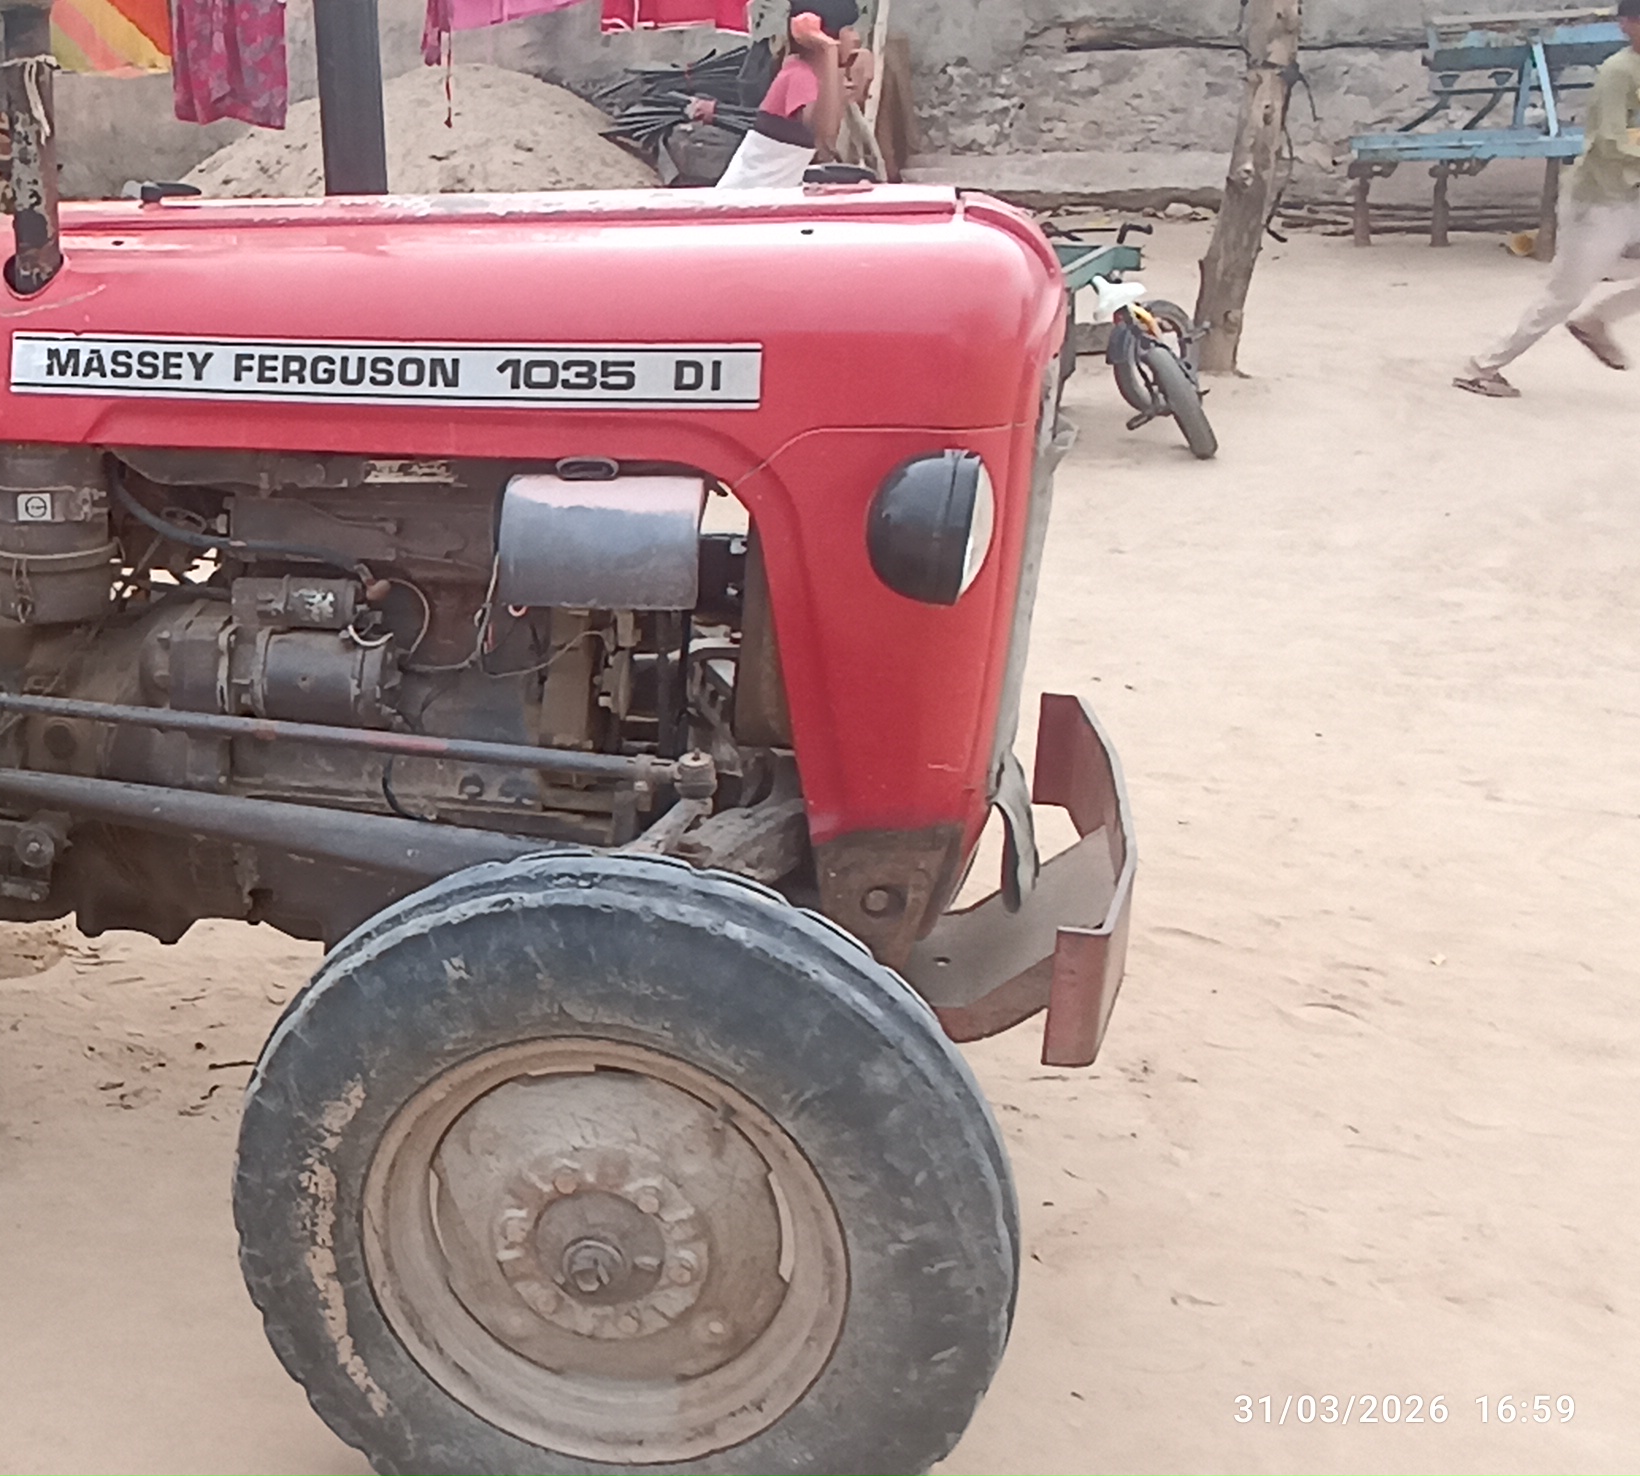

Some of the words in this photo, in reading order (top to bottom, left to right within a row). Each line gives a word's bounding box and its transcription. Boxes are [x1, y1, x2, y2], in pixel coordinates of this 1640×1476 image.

[45, 347, 214, 381] MASSEY
[233, 353, 460, 388] FERGUSON
[496, 359, 636, 391] 1035
[673, 360, 722, 391] DI
